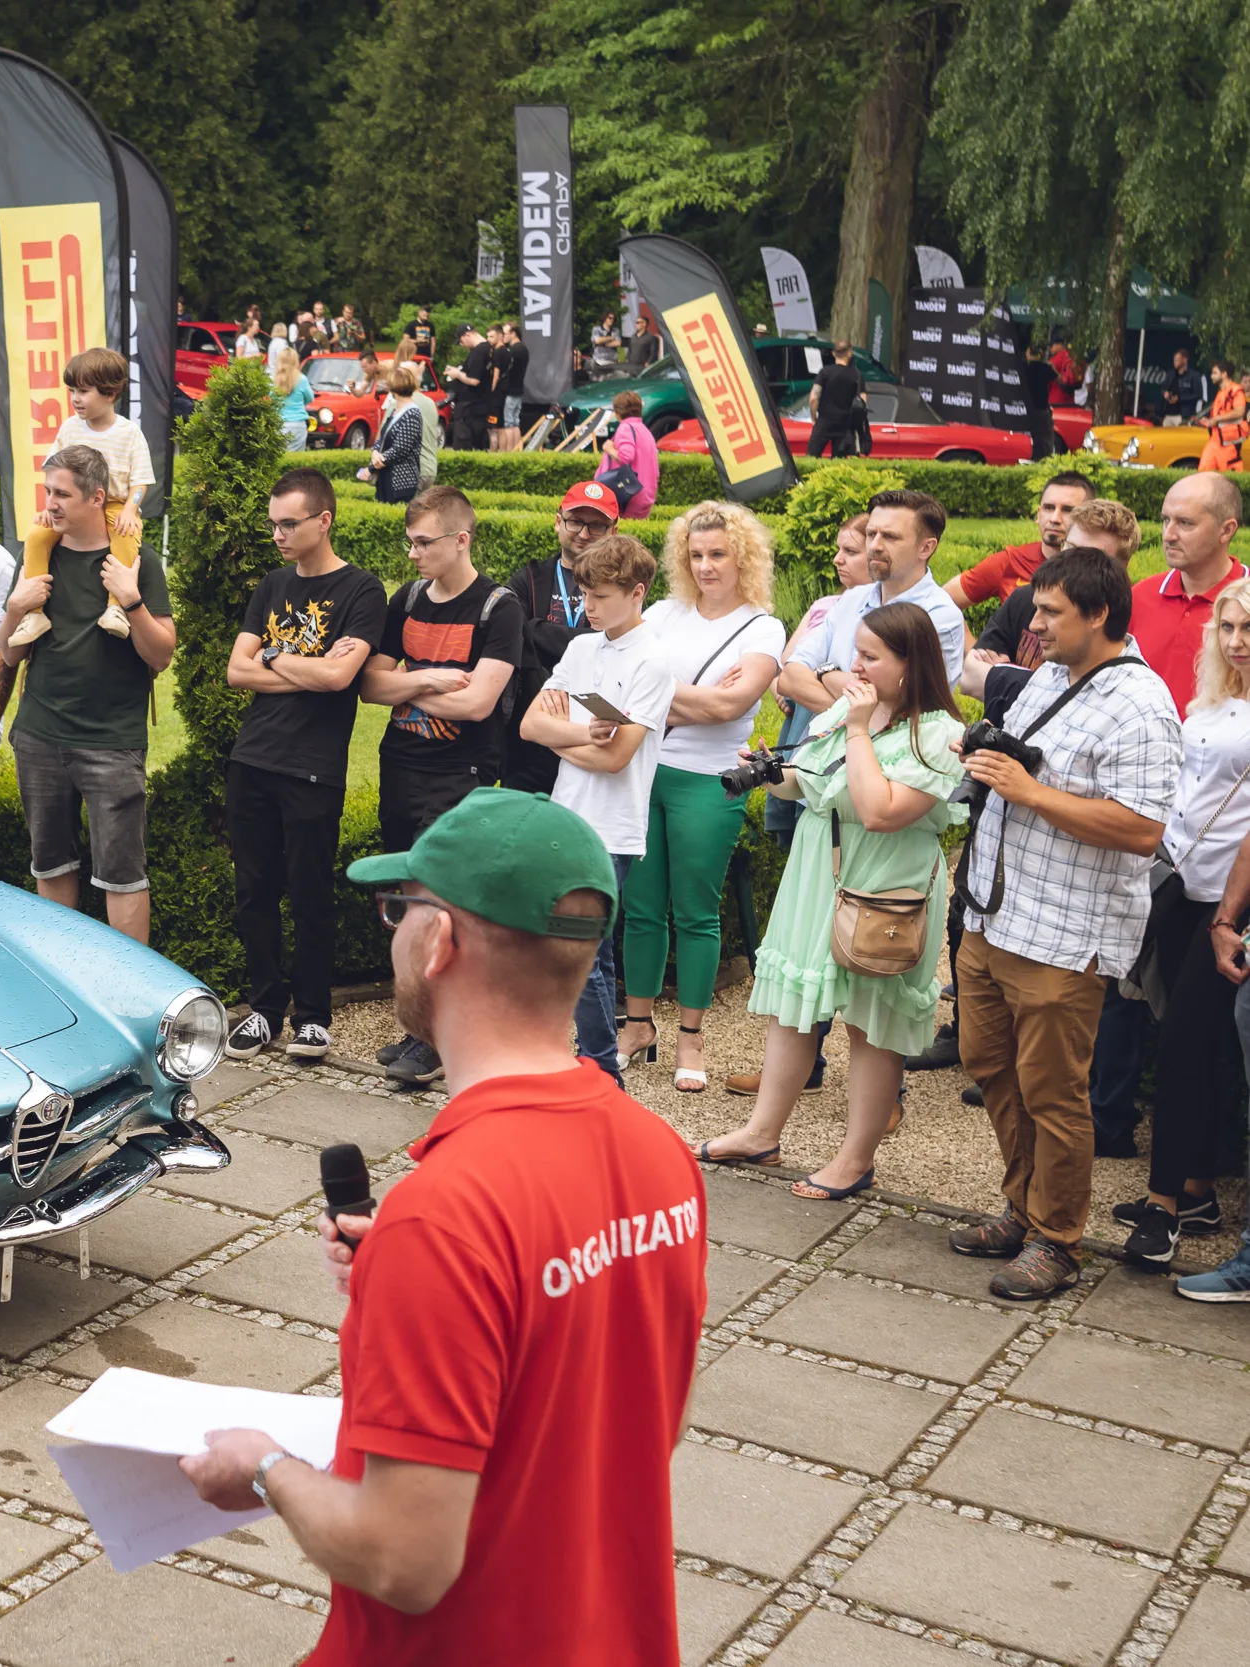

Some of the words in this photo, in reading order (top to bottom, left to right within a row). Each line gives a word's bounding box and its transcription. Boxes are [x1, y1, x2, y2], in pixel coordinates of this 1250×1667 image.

[914, 300, 947, 313] TANDEM
[912, 330, 942, 343] TANDEM
[952, 333, 981, 347] TANDEM
[909, 360, 937, 373] TANDEM
[947, 364, 976, 377] TANDEM
[942, 394, 972, 407] TANDEM
